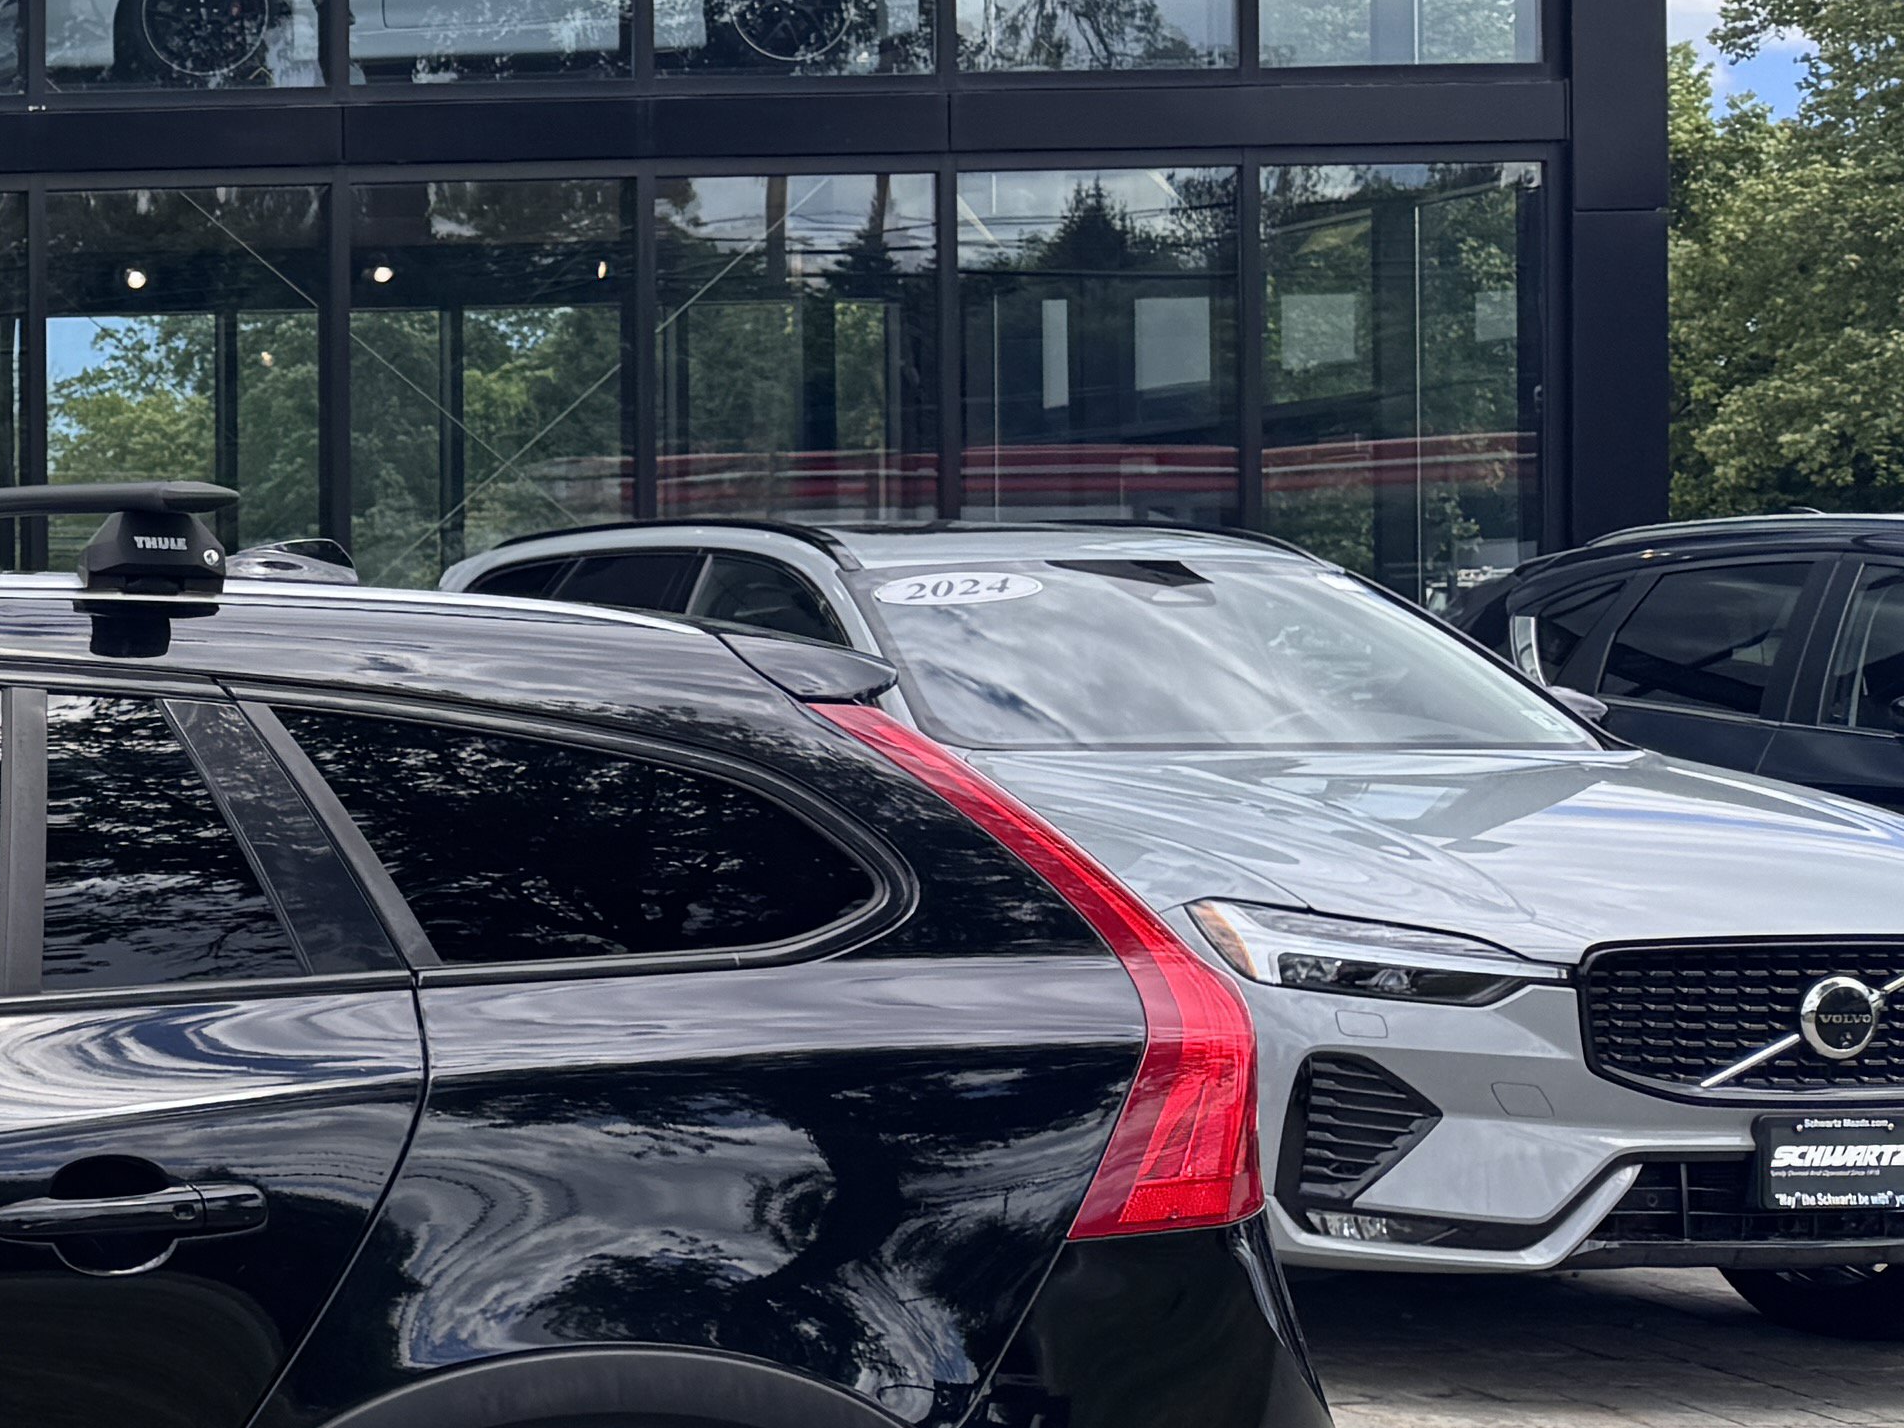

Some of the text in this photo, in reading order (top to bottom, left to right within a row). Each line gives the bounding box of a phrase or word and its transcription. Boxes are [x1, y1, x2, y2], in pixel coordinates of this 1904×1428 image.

[133, 536, 188, 551] THULE
[905, 577, 1010, 601] 2024
[1818, 1013, 1872, 1024] VOLVO
